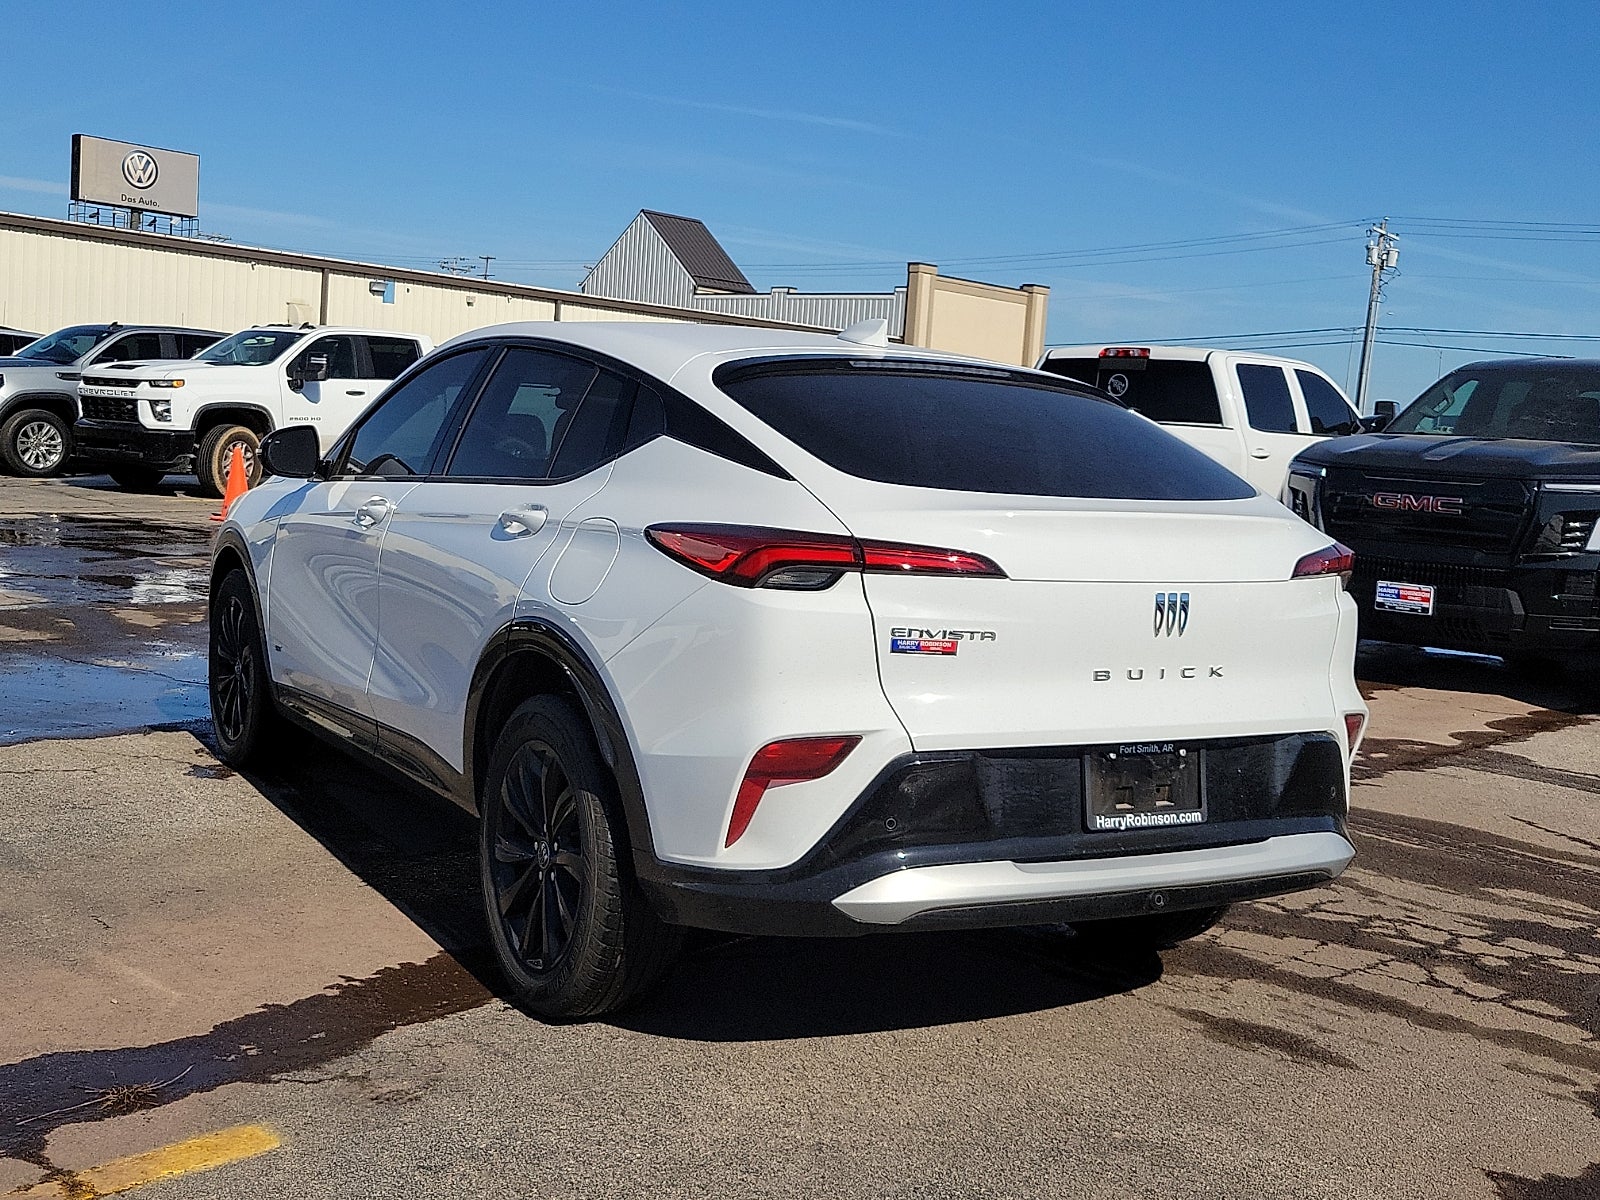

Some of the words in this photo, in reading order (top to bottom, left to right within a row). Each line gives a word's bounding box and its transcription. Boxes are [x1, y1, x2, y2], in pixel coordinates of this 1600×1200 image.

[121, 193, 136, 204] Das
[138, 197, 160, 208] Auto.
[78, 387, 136, 397] CHEVROLET
[1373, 492, 1463, 515] GMC
[891, 627, 996, 640] ENVISTA
[1093, 666, 1223, 681] BUICK
[1120, 745, 1136, 754] Fort
[1137, 744, 1160, 753] Smith,
[1162, 744, 1174, 752] AR
[1096, 812, 1202, 830] HarryRobinson.com
